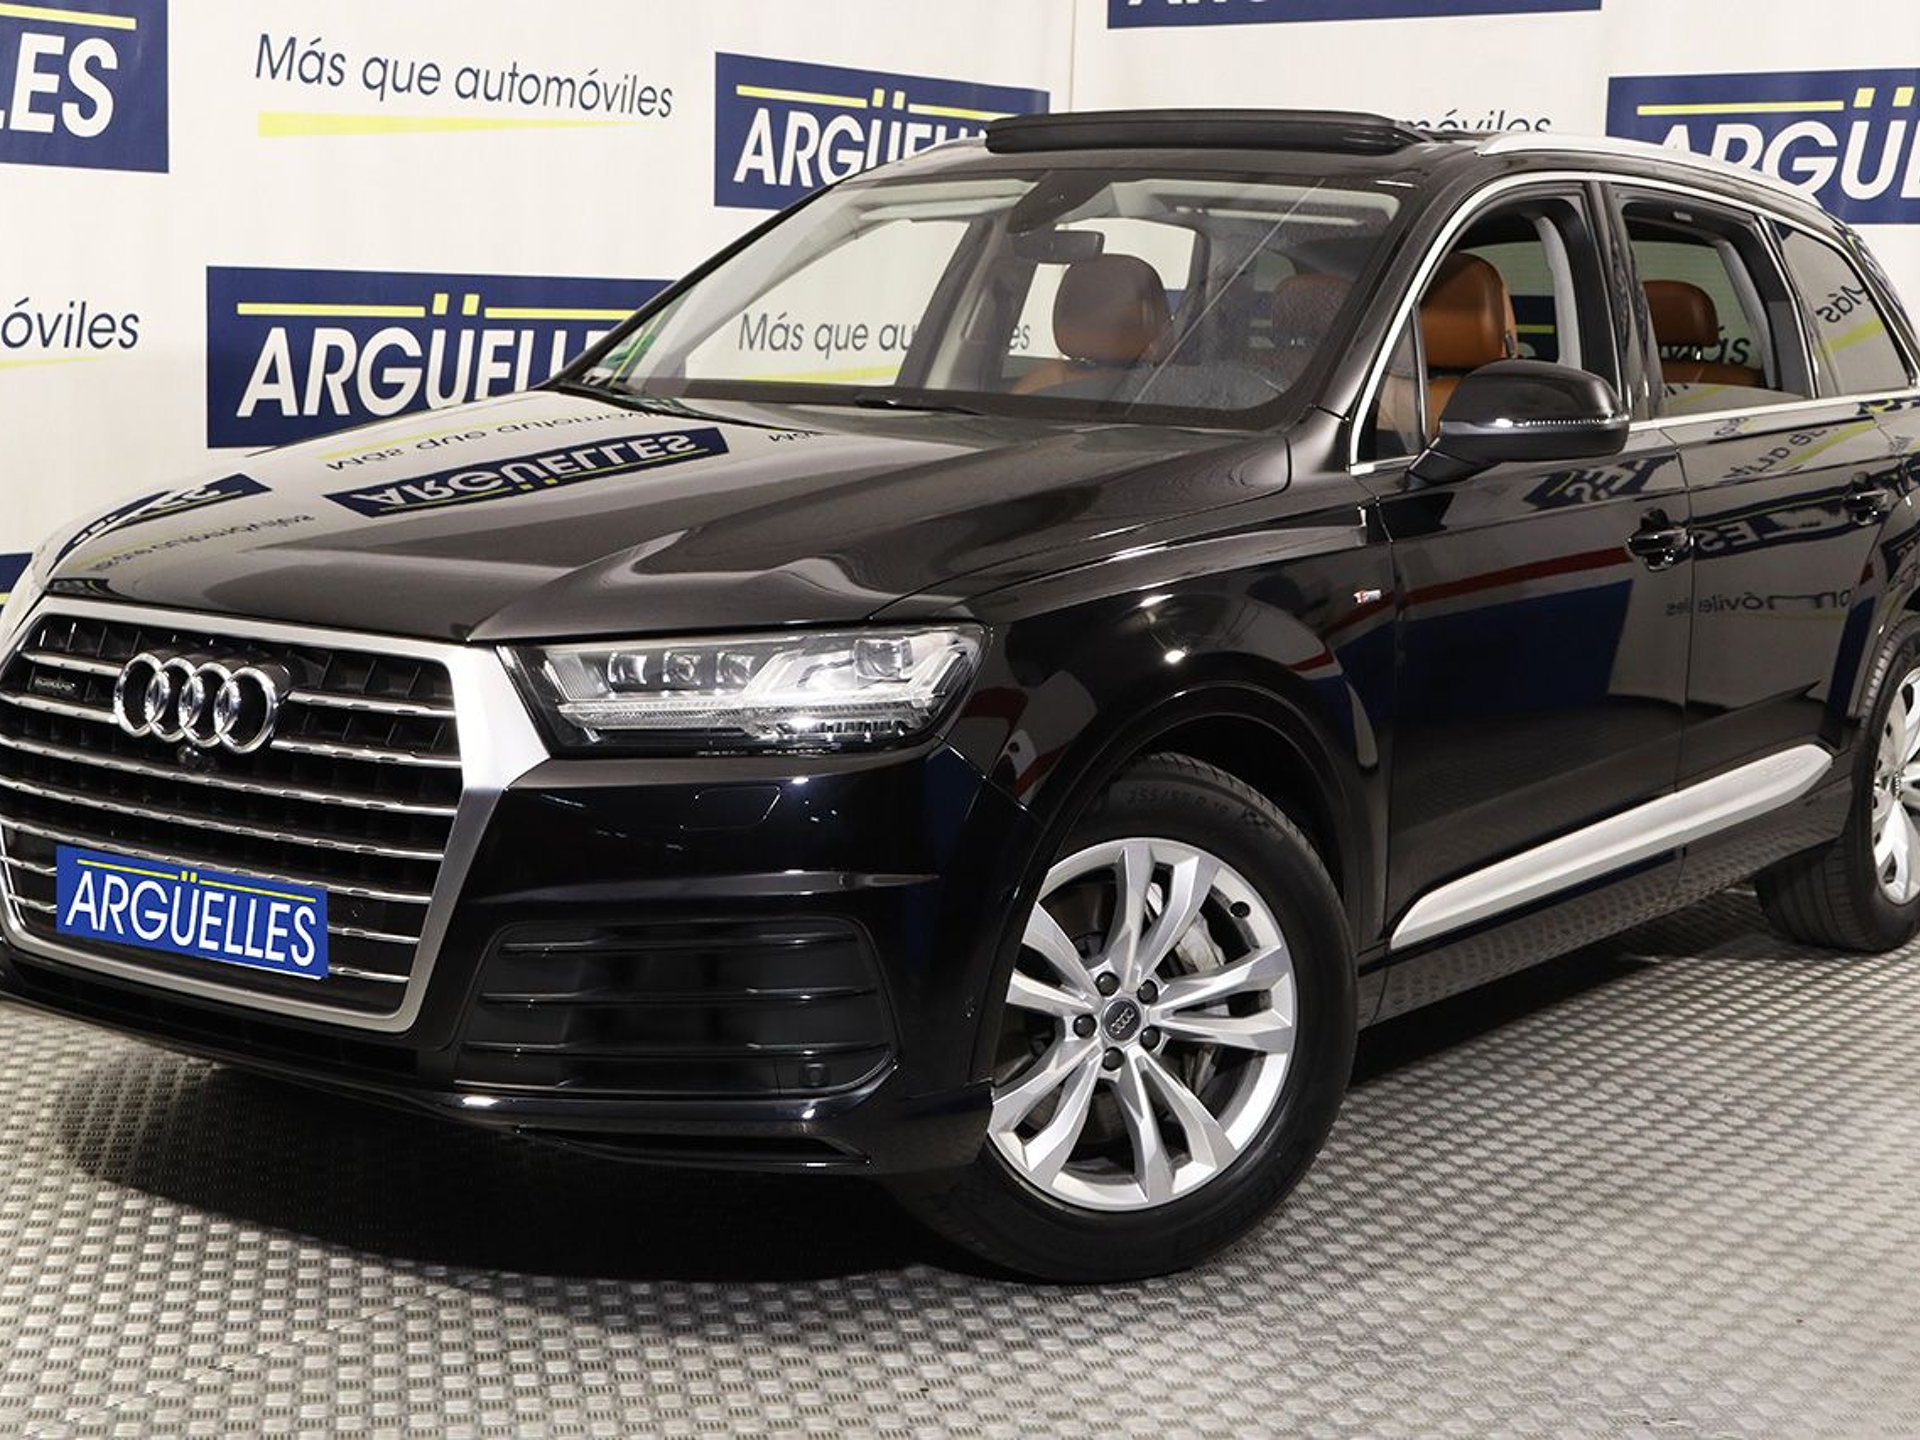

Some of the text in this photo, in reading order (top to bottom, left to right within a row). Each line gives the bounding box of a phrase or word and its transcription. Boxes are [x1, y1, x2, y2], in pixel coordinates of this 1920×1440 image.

[255, 33, 674, 118] Más que automóviles
[738, 311, 804, 351] Más
[813, 323, 868, 359] que
[65, 871, 317, 968] ARGÜELLES
